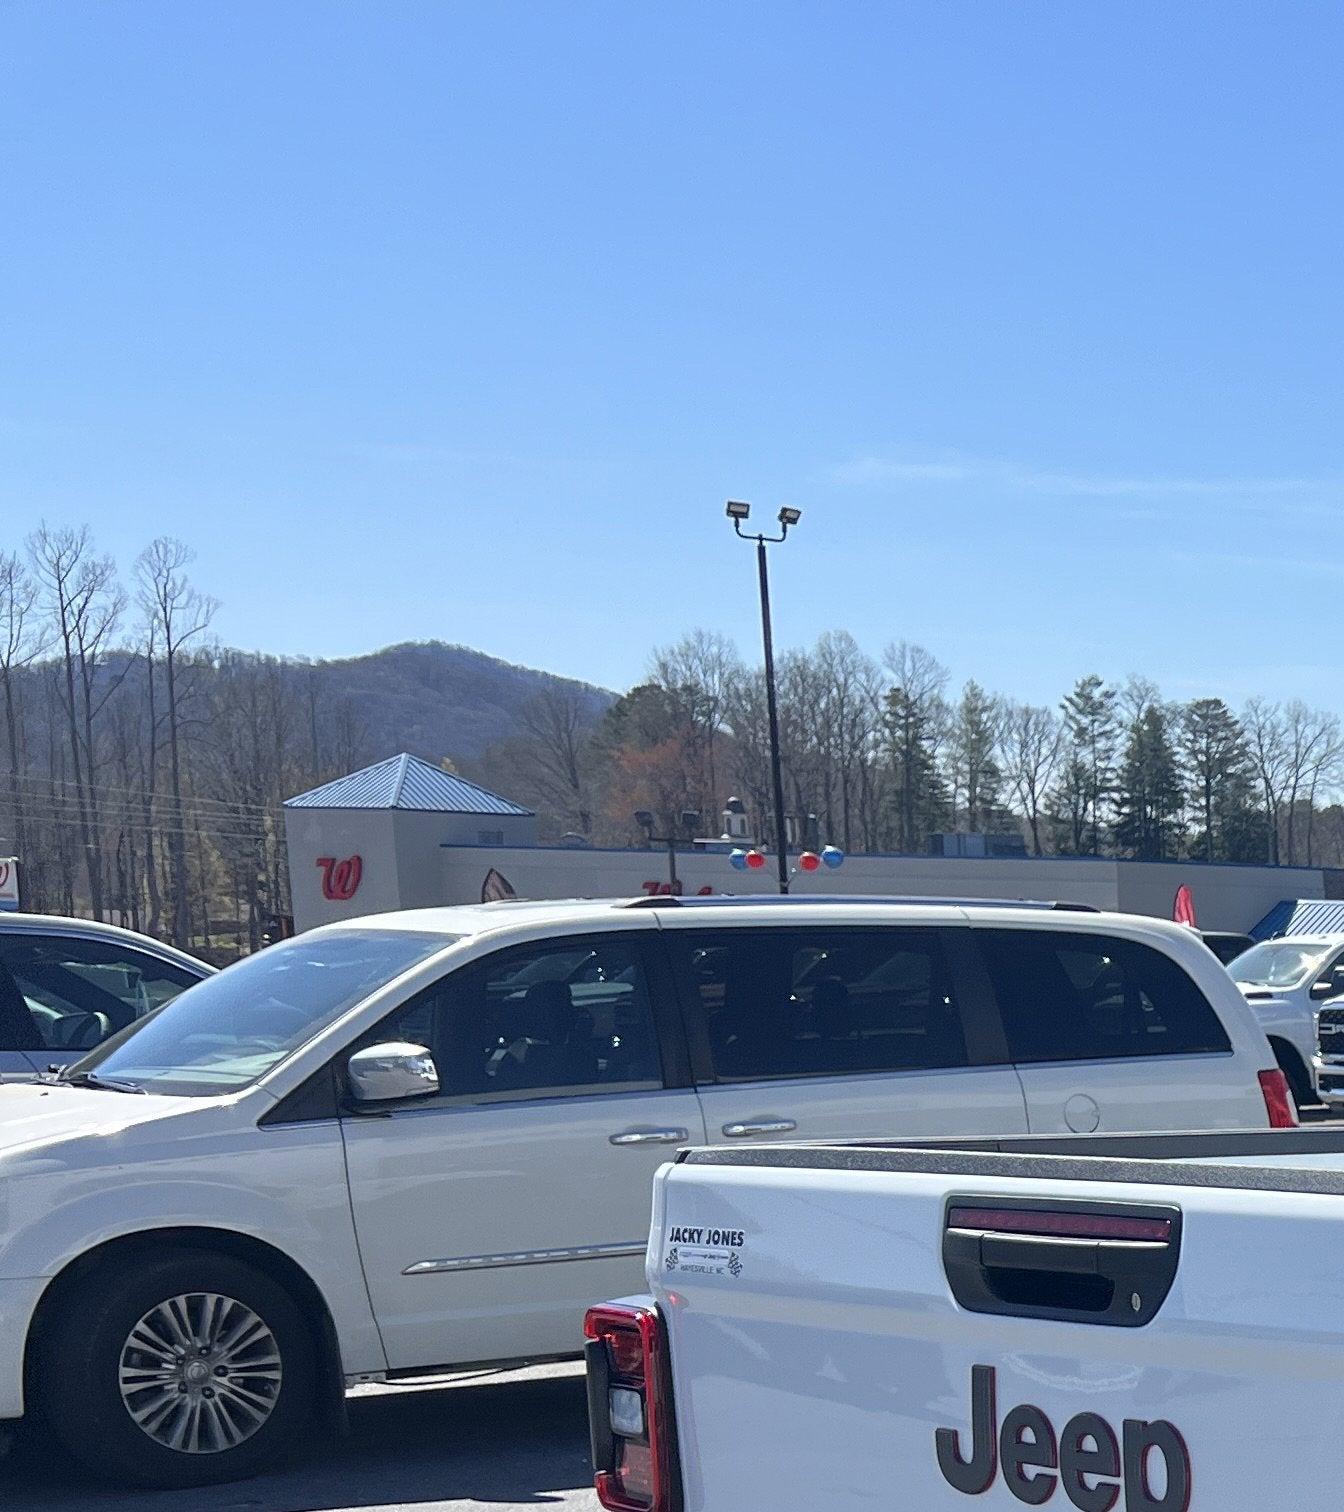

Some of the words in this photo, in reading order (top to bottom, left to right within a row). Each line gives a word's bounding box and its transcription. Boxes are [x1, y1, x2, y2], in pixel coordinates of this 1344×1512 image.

[316, 855, 363, 901] W
[670, 1227, 703, 1243] JACKY
[706, 1229, 744, 1246] JONES
